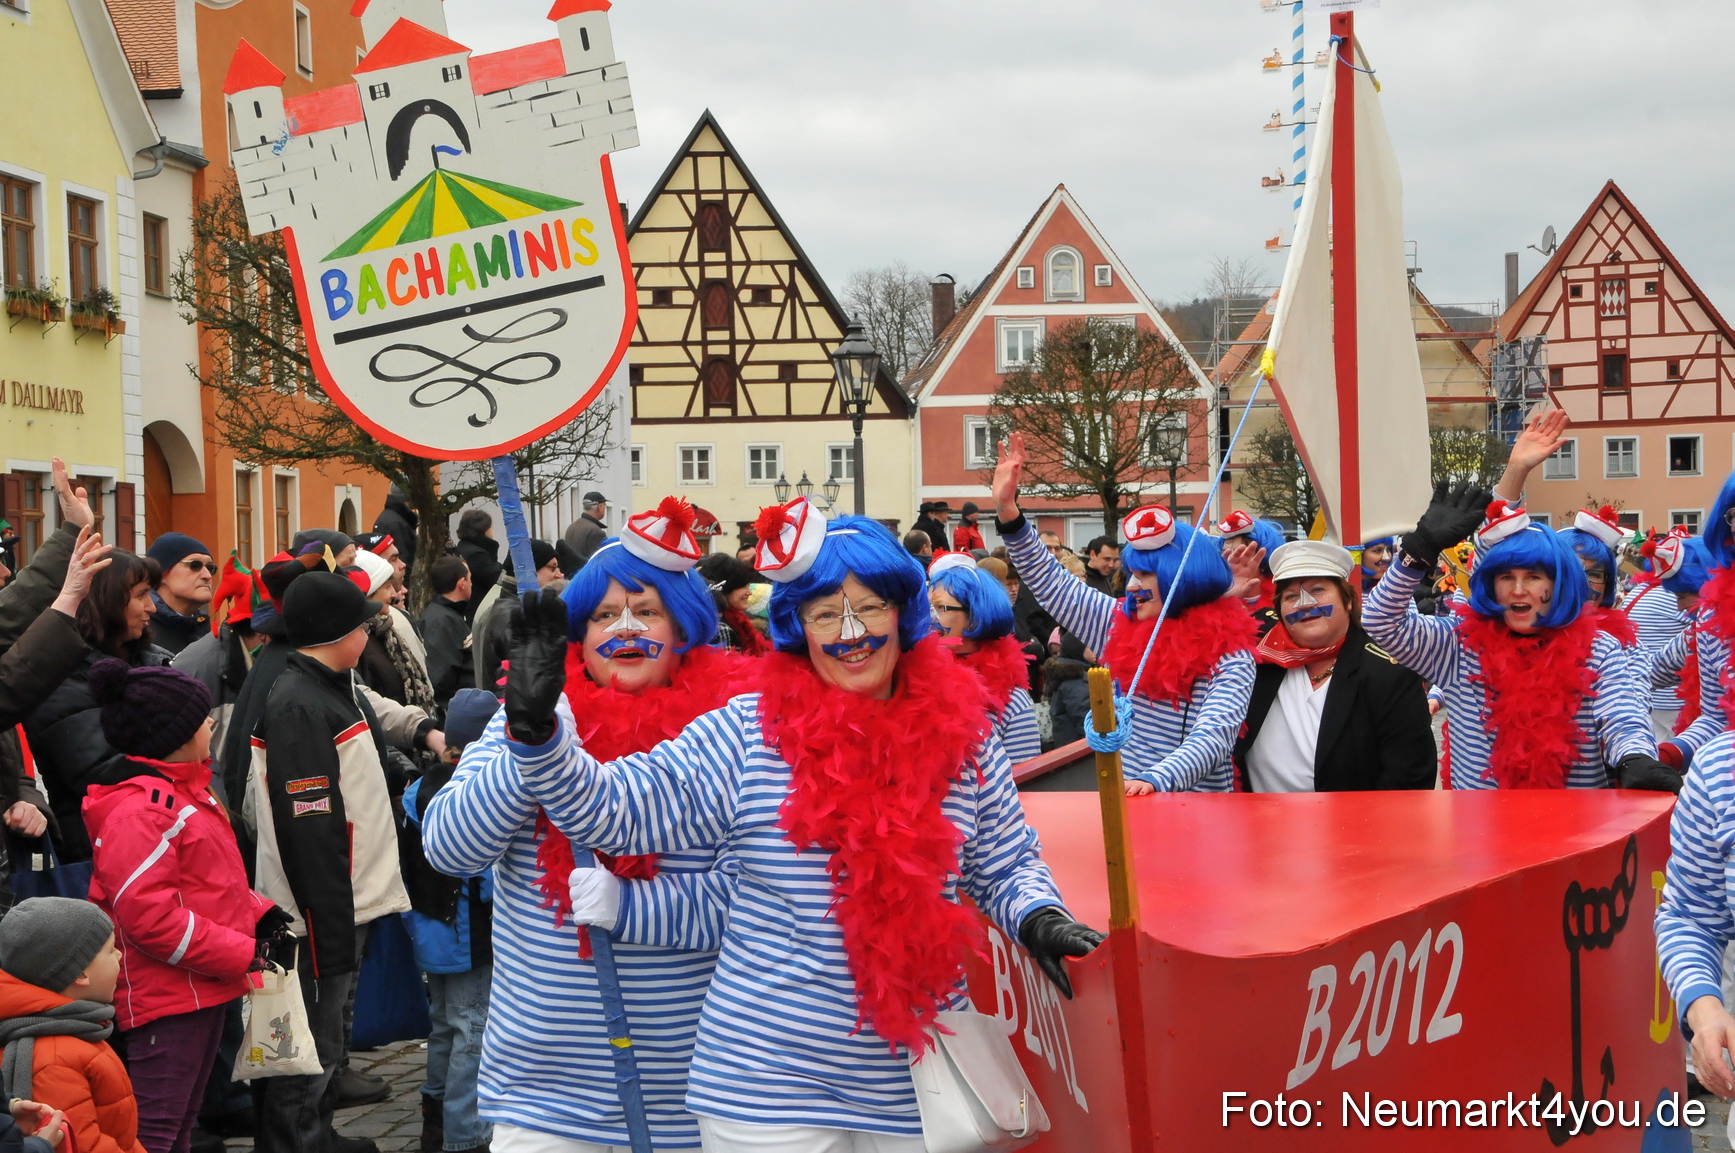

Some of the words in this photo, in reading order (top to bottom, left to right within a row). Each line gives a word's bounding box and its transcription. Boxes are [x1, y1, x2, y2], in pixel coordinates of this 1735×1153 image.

[320, 218, 599, 321] BACHAMINIS
[12, 380, 85, 415] DALLMAYR
[689, 518, 718, 535] lash
[296, 802, 314, 813] GRAND
[315, 800, 328, 811] PRIX
